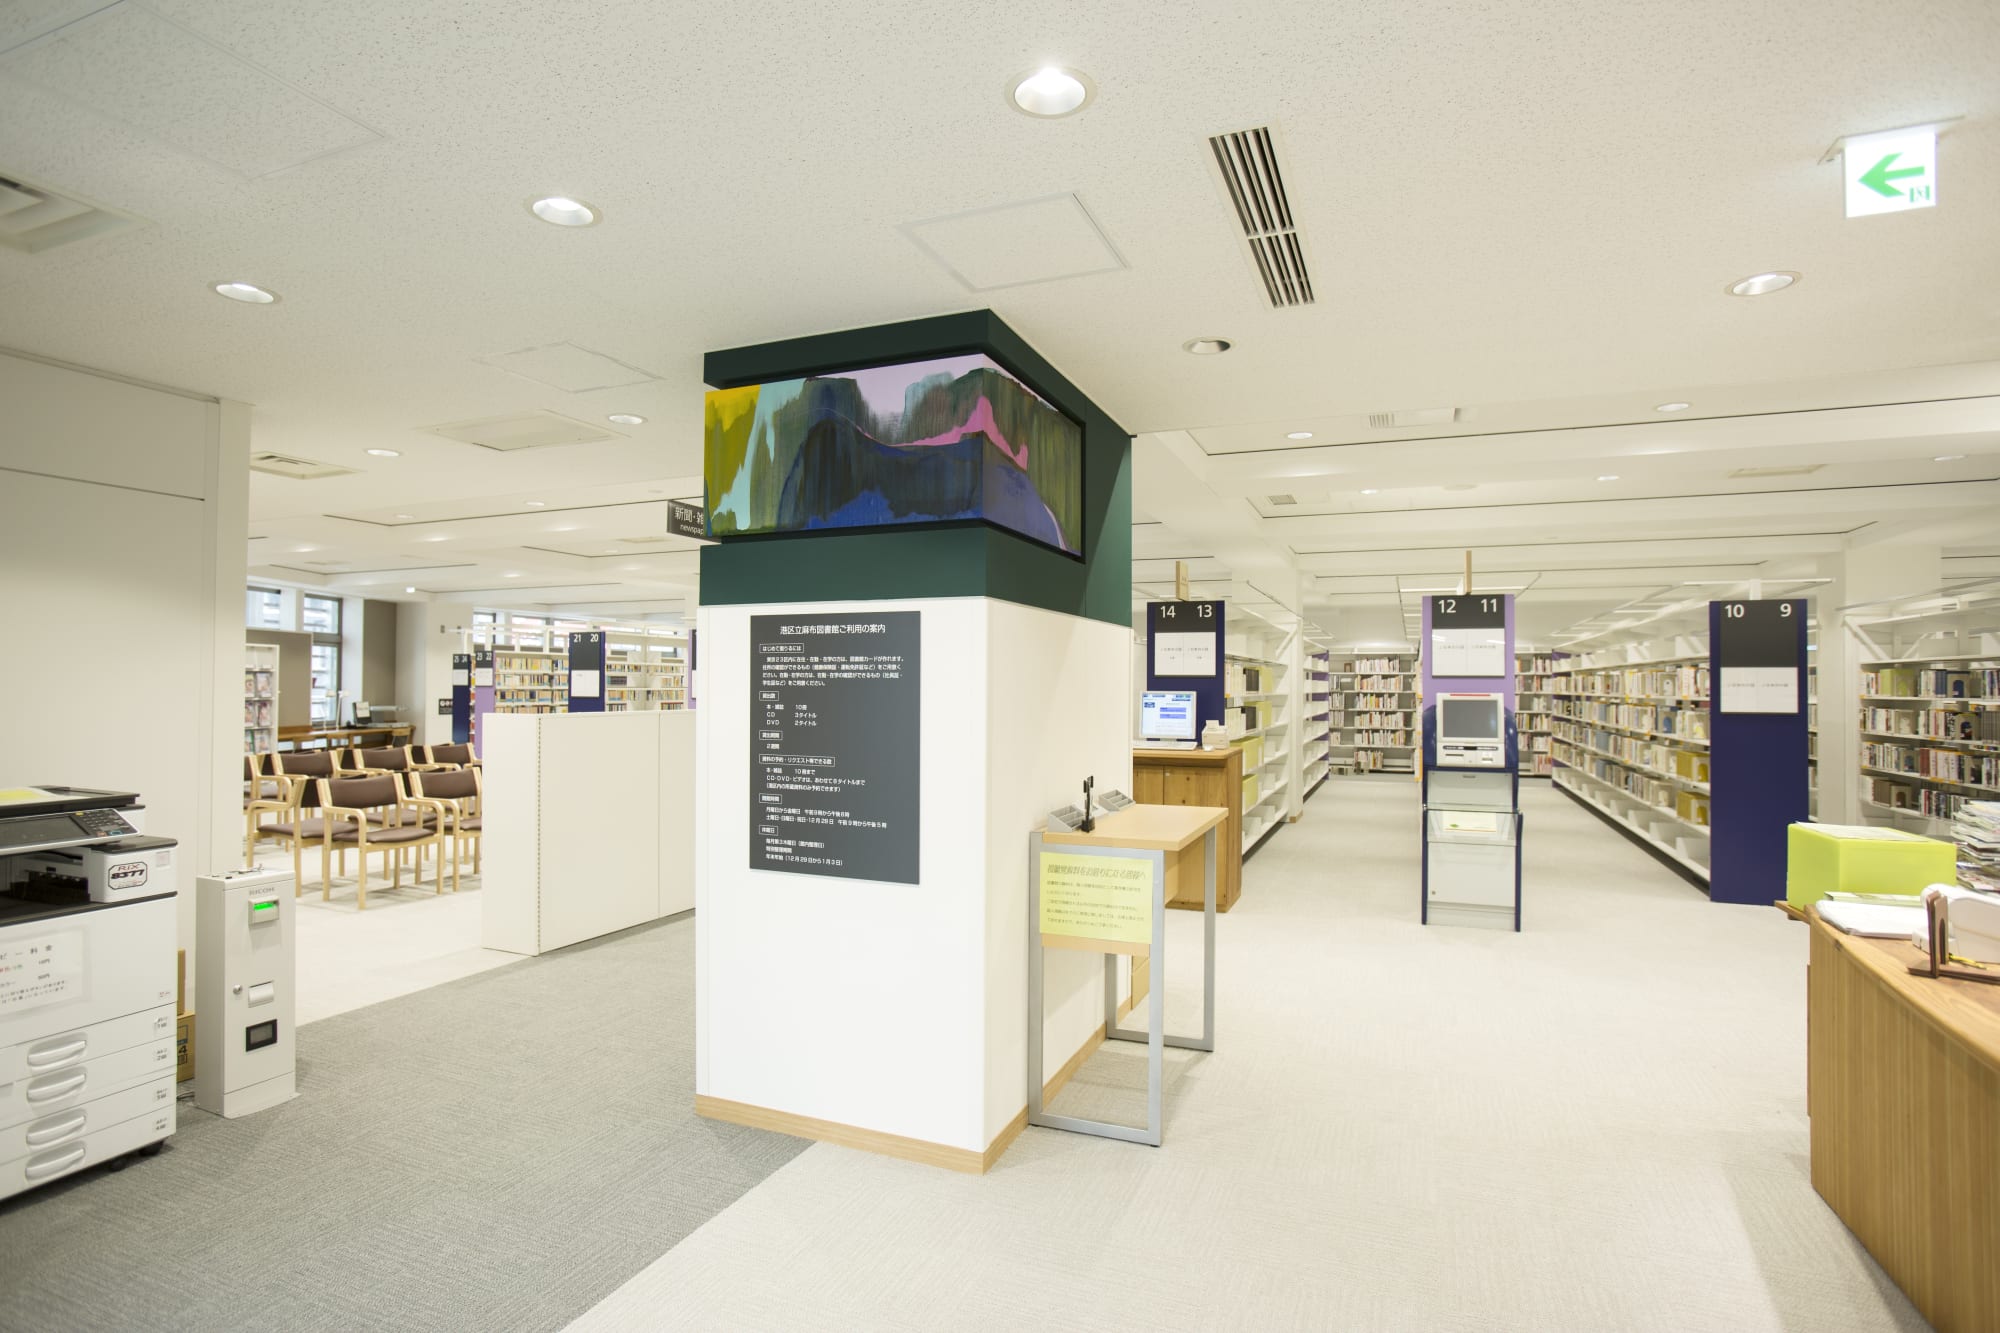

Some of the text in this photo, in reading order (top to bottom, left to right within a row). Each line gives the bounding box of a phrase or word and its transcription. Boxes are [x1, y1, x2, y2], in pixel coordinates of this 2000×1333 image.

[1160, 604, 1213, 618] 14 13
[1438, 598, 1497, 614] 12 11
[1724, 603, 1792, 618] 10 9
[780, 624, 886, 635] 港区立麻布図書館ご利用の案内
[574, 634, 599, 642] 21 20
[486, 652, 492, 661] 22
[249, 886, 275, 896] RICOH
